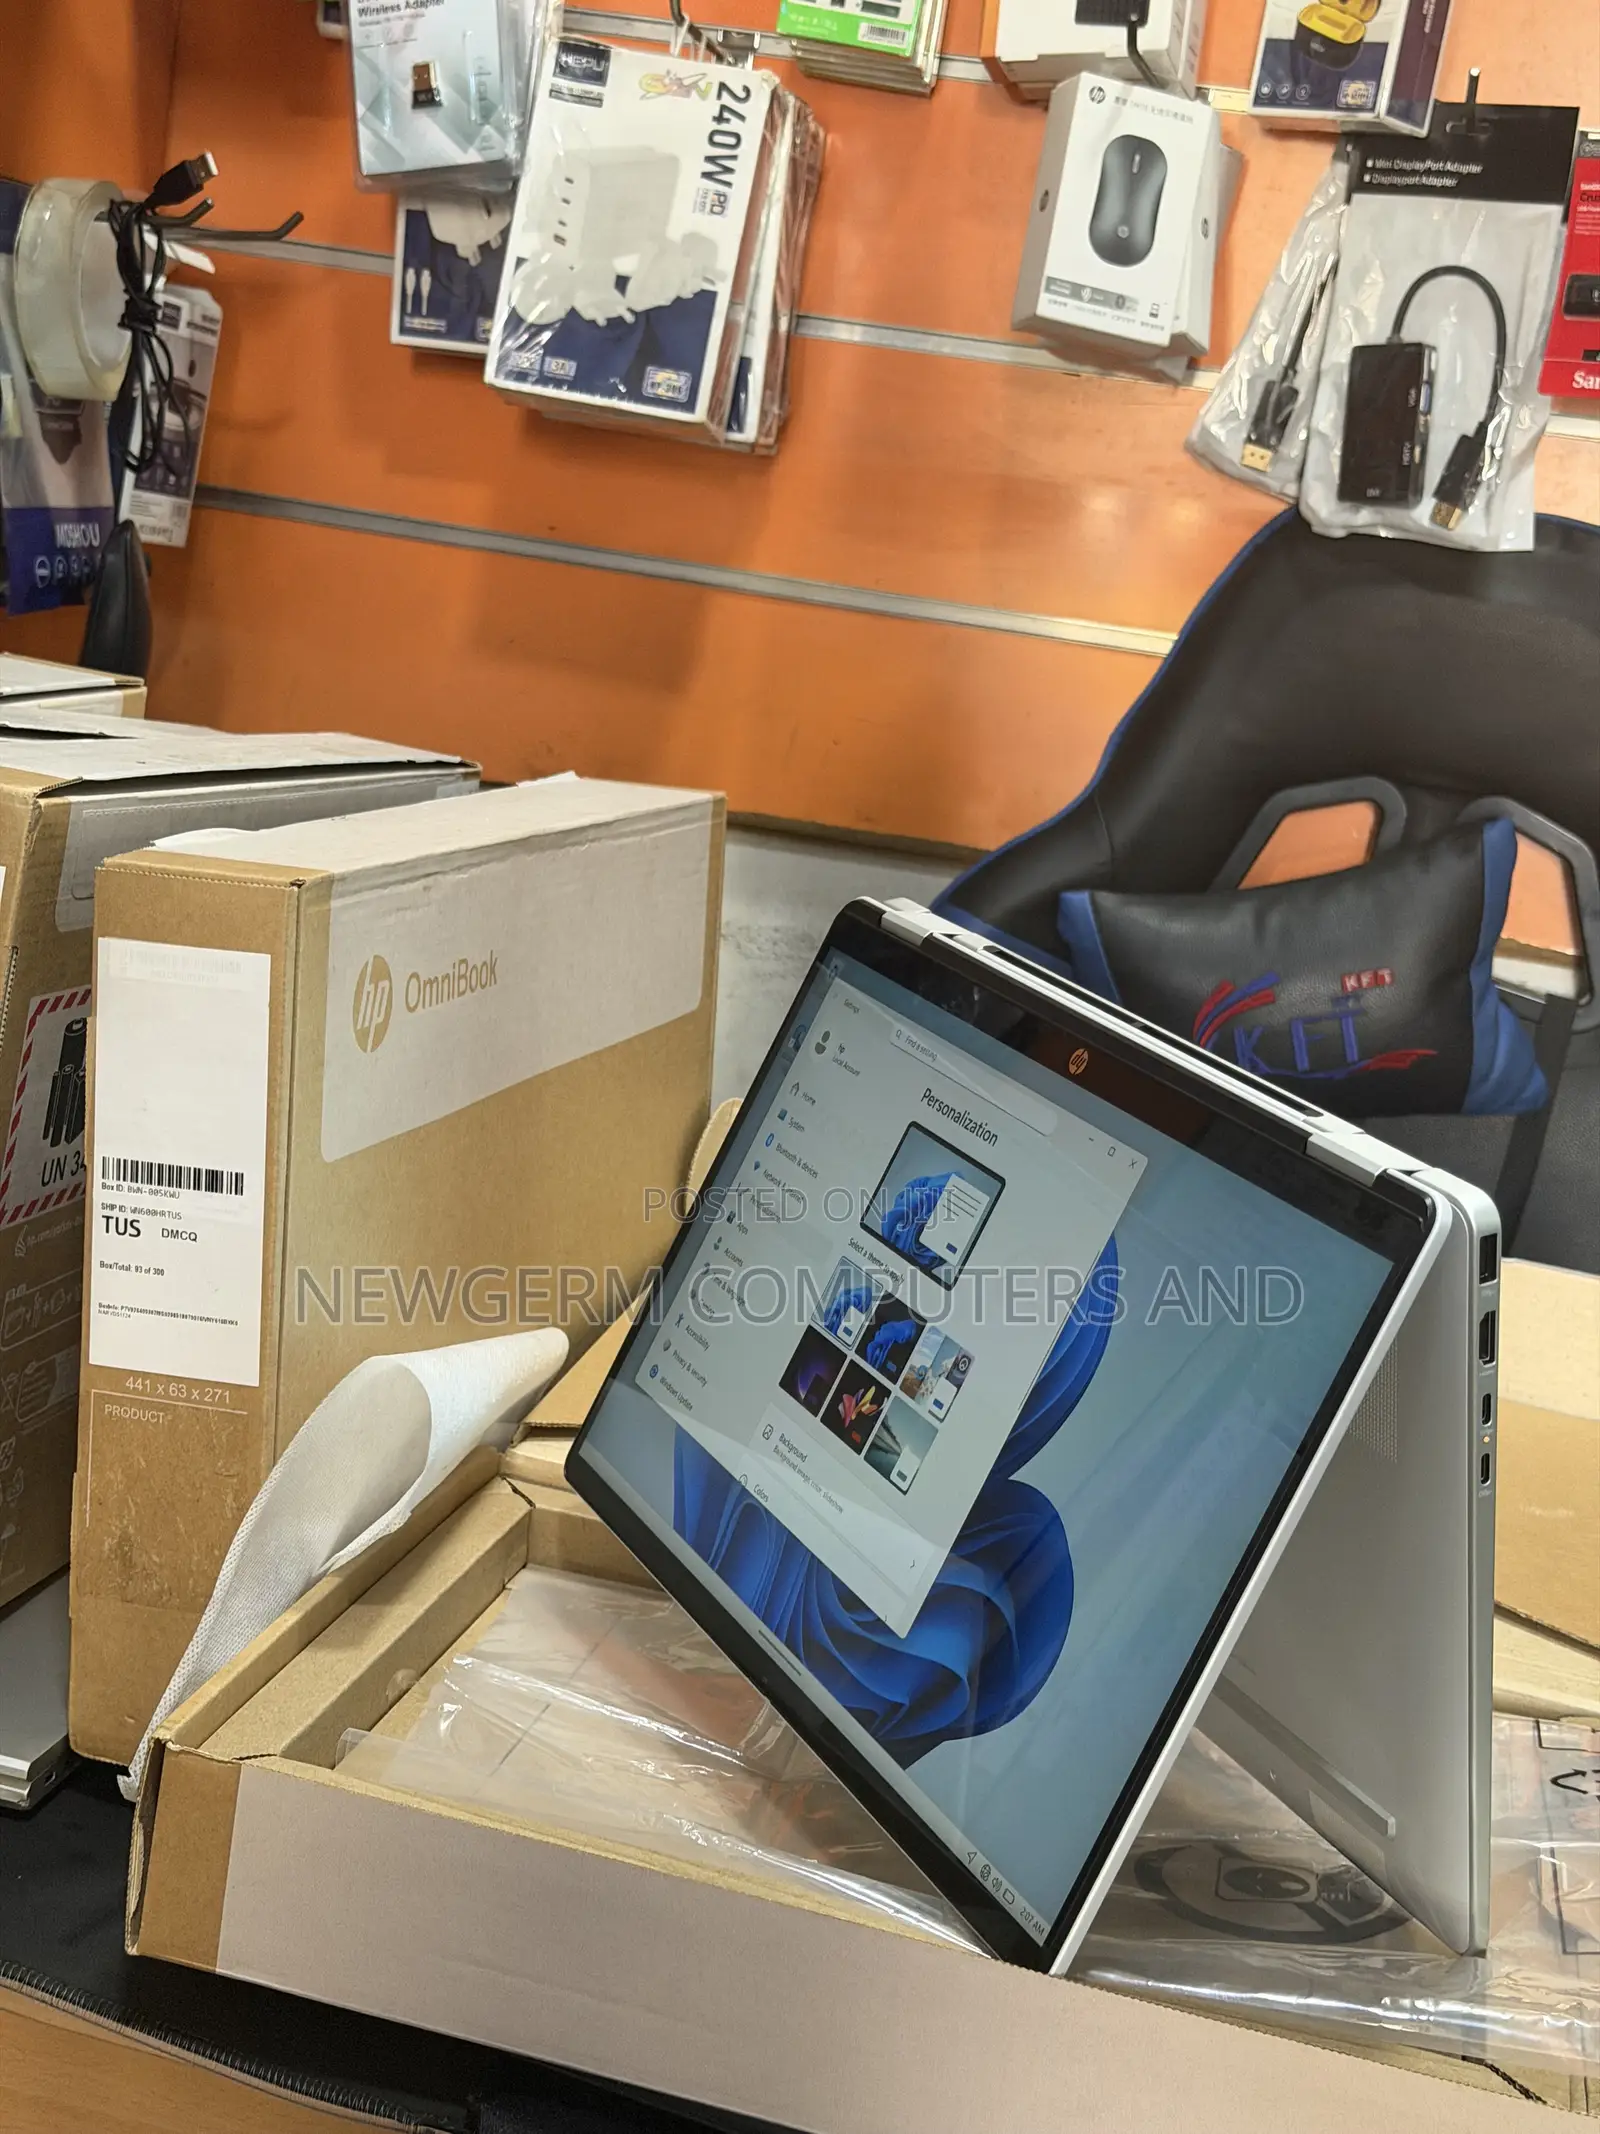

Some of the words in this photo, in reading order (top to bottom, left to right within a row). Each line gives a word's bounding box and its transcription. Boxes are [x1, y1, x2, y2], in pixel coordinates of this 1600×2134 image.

[700, 81, 752, 189] 240W
[405, 949, 499, 1014] OmniBook
[905, 1035, 917, 1049] Find
[919, 1044, 938, 1062] setting
[801, 1090, 816, 1106] Home
[788, 1116, 806, 1133] System
[920, 1087, 999, 1148] Personalization
[41, 1154, 68, 1188] UN
[801, 1163, 819, 1179] devices
[101, 1181, 115, 1192] Box
[115, 1183, 126, 1194] ID:
[100, 1202, 118, 1213] SHIP
[118, 1204, 128, 1214] ID:
[101, 1215, 142, 1239] TUS
[161, 1227, 198, 1243] DMCQ
[736, 1221, 749, 1236] Apps
[724, 1246, 744, 1267] Accounts
[847, 1236, 865, 1255] Select
[99, 1260, 133, 1273] Box/Total:
[143, 1266, 152, 1275] of
[685, 1325, 710, 1351] Accessibility
[672, 1349, 687, 1369] Privacy
[691, 1369, 708, 1388] security
[125, 1376, 151, 1393] 441
[156, 1383, 165, 1395] x
[169, 1382, 187, 1398] 63
[191, 1388, 200, 1401] x
[203, 1387, 231, 1404] 271
[659, 1375, 679, 1398] Windows
[677, 1390, 693, 1412] Update
[104, 1404, 165, 1424] PRODUCT
[773, 1444, 799, 1471] Background
[778, 1432, 808, 1463] Background
[753, 1483, 770, 1504] Colors
[1032, 1919, 1045, 1936] AM
